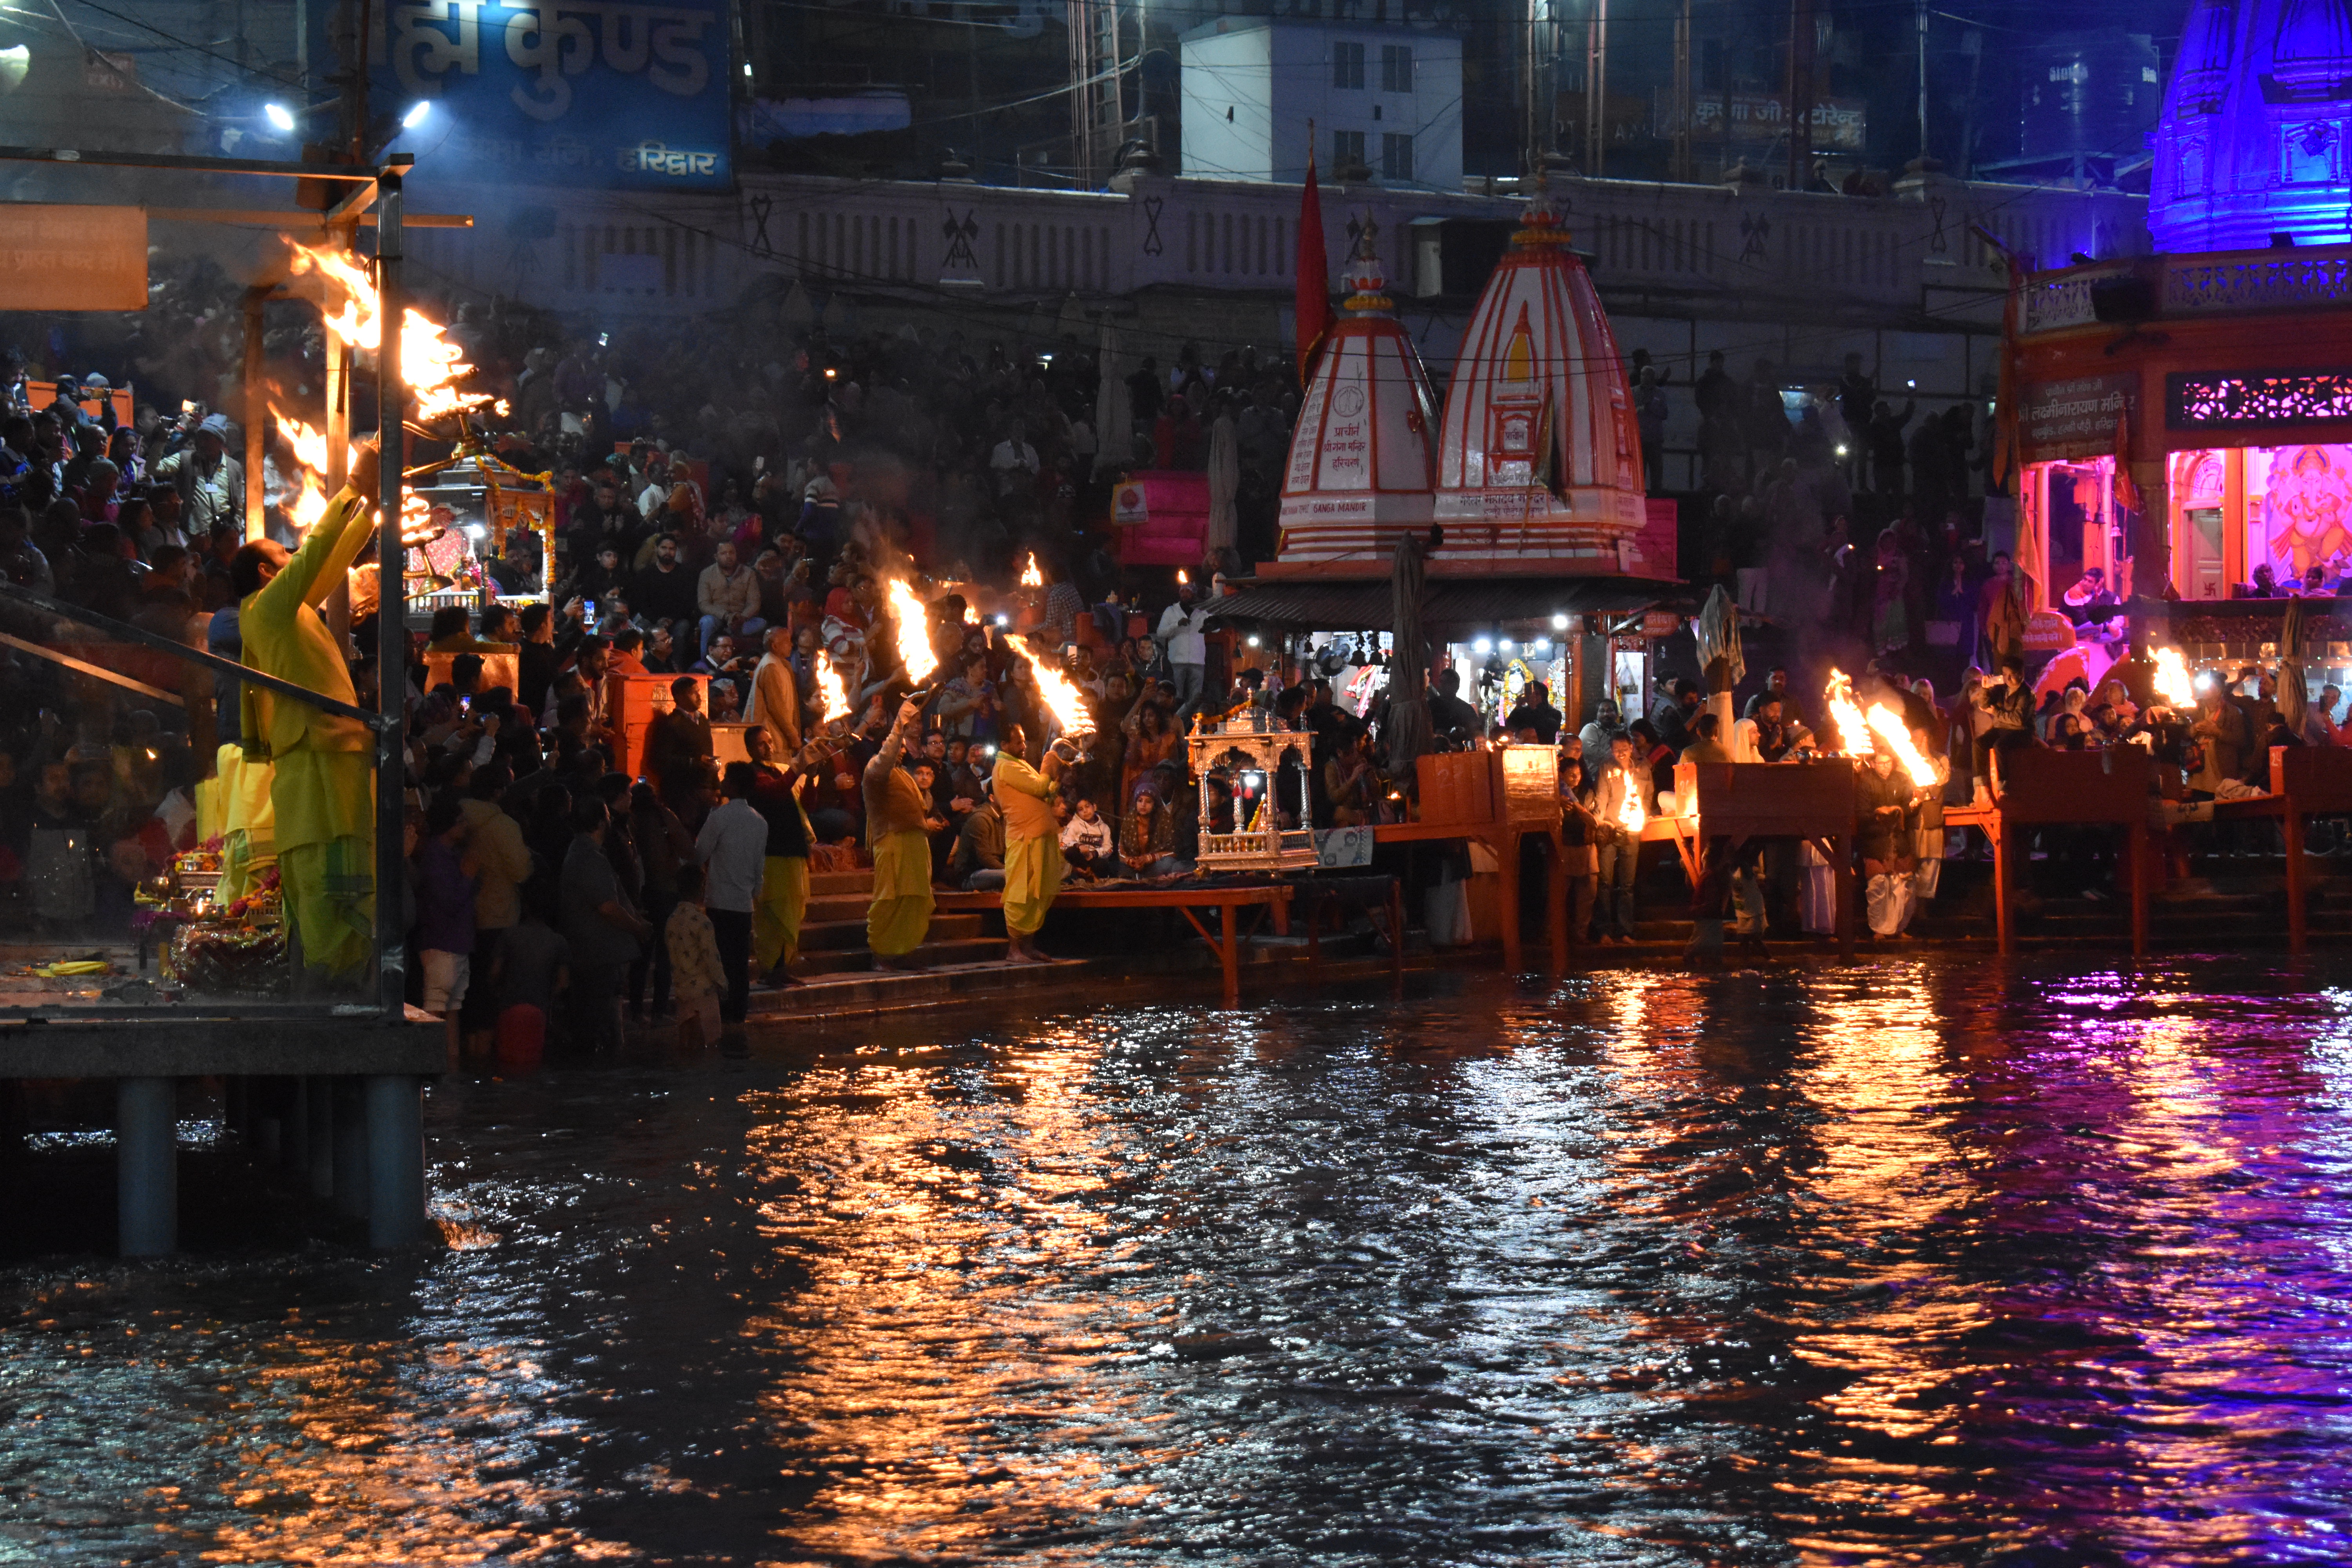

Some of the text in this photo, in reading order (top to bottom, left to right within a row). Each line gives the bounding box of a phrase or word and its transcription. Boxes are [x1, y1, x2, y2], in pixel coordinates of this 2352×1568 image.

[505, 0, 715, 121] कुण्ड
[1755, 100, 1782, 122] जी
[615, 139, 717, 176] हरिद्वार
[2092, 378, 2102, 391] जी
[2031, 398, 2098, 421] लक्ष्मीनारायण
[2100, 391, 2136, 412] मन्िर
[1334, 423, 1359, 437] प्राचीन
[1505, 428, 1524, 440] प्राचीन
[1332, 441, 1346, 452] गंगा
[1348, 440, 1366, 452] मन्दिर
[1313, 503, 1335, 513] GANGA
[1338, 502, 1366, 512] MANDIR
